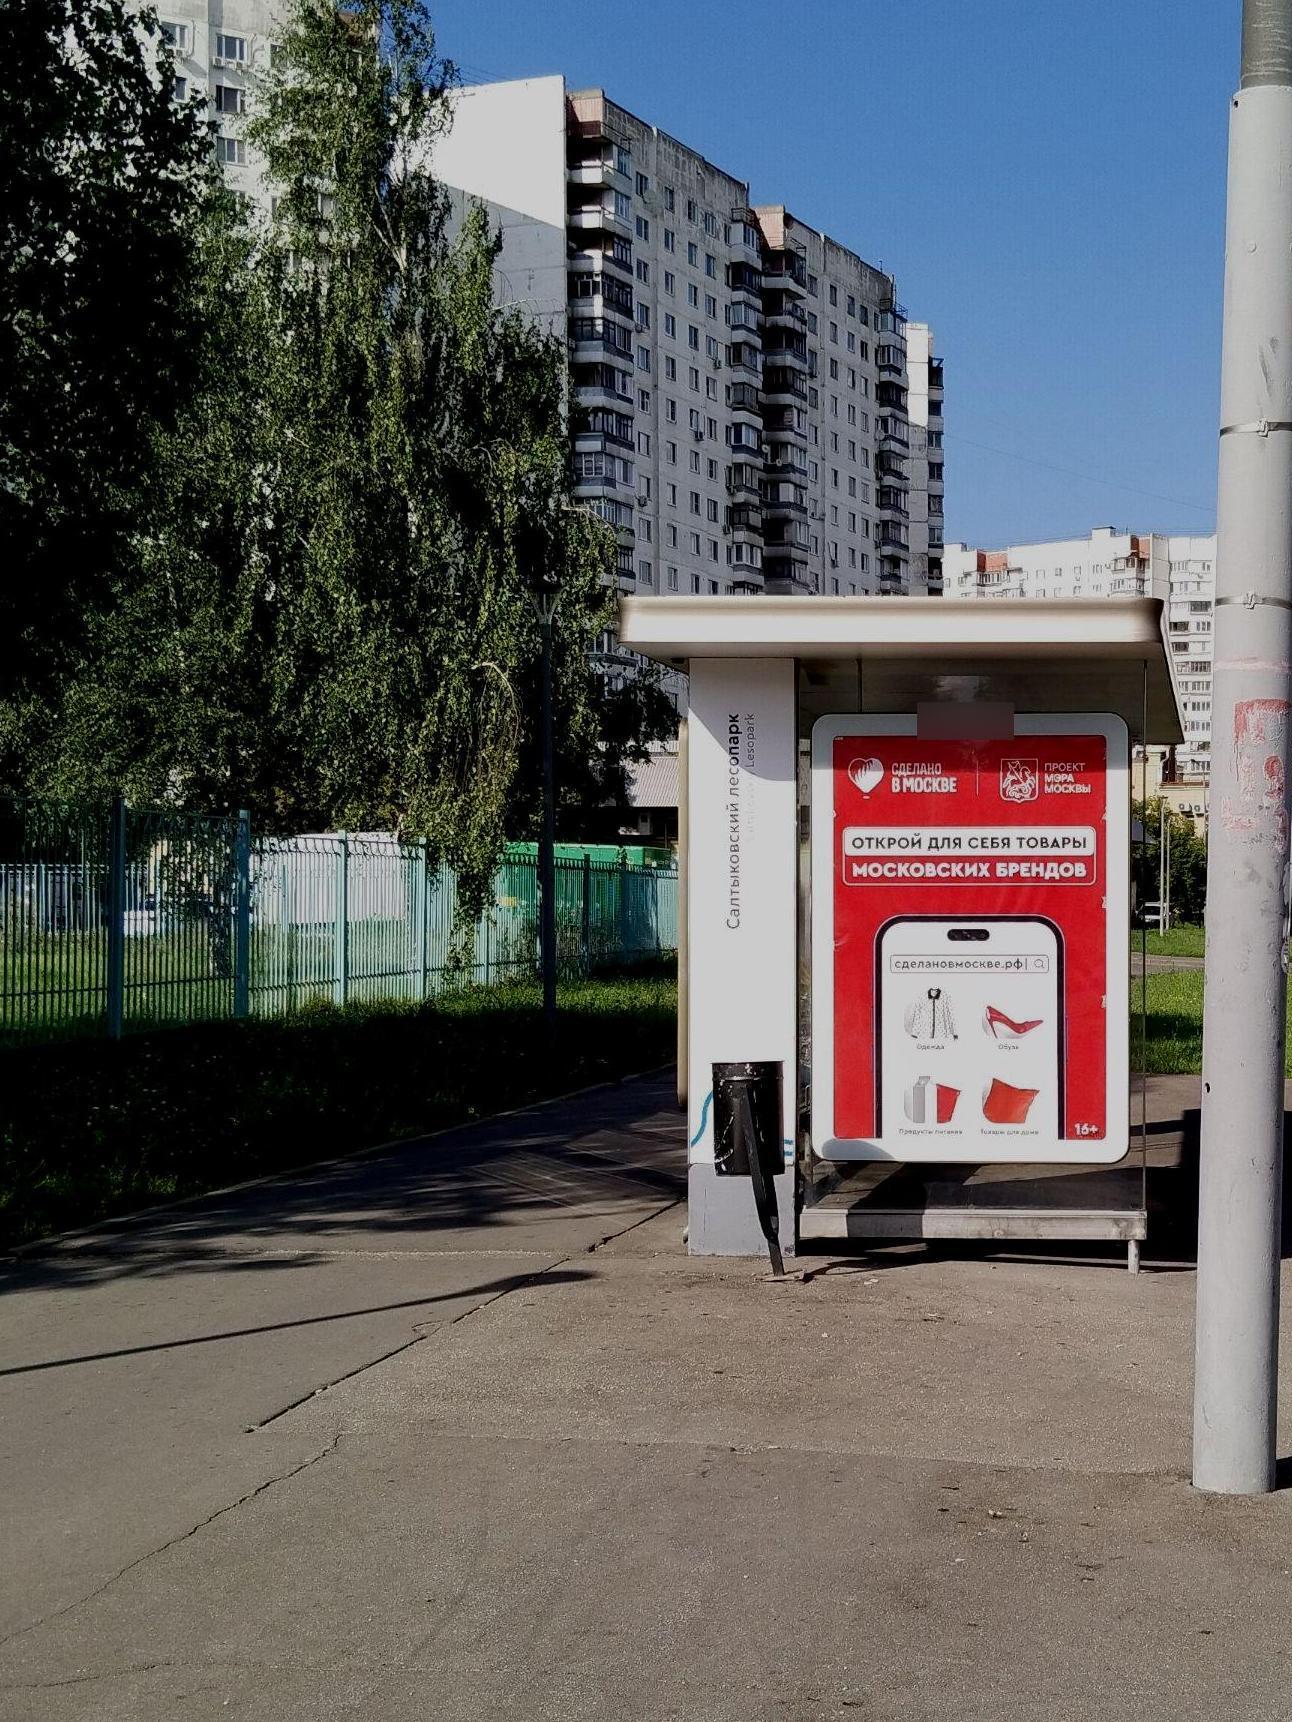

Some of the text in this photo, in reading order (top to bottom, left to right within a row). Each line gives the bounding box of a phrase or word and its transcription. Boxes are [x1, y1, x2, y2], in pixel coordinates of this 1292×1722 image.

[744, 713, 755, 767] Lesopark
[891, 763, 942, 776] СДЕЛАНО
[1044, 763, 1086, 772] ПРОЕКТ
[891, 777, 957, 793] В МОСКВЕ
[1044, 774, 1074, 783] МЭРА
[1044, 784, 1091, 794] МОСКВЫ
[726, 713, 743, 929] Салтыковский лесопарк
[852, 833, 1087, 851] ОТКРОЙ ДЛЯ СЕБЯ ТОВАРЫ
[852, 862, 1087, 880] МОСКОВСКИХ БРЕНДОВ
[894, 957, 1023, 971] сделановмоскве.рф
[1074, 1123, 1099, 1135] 16+
